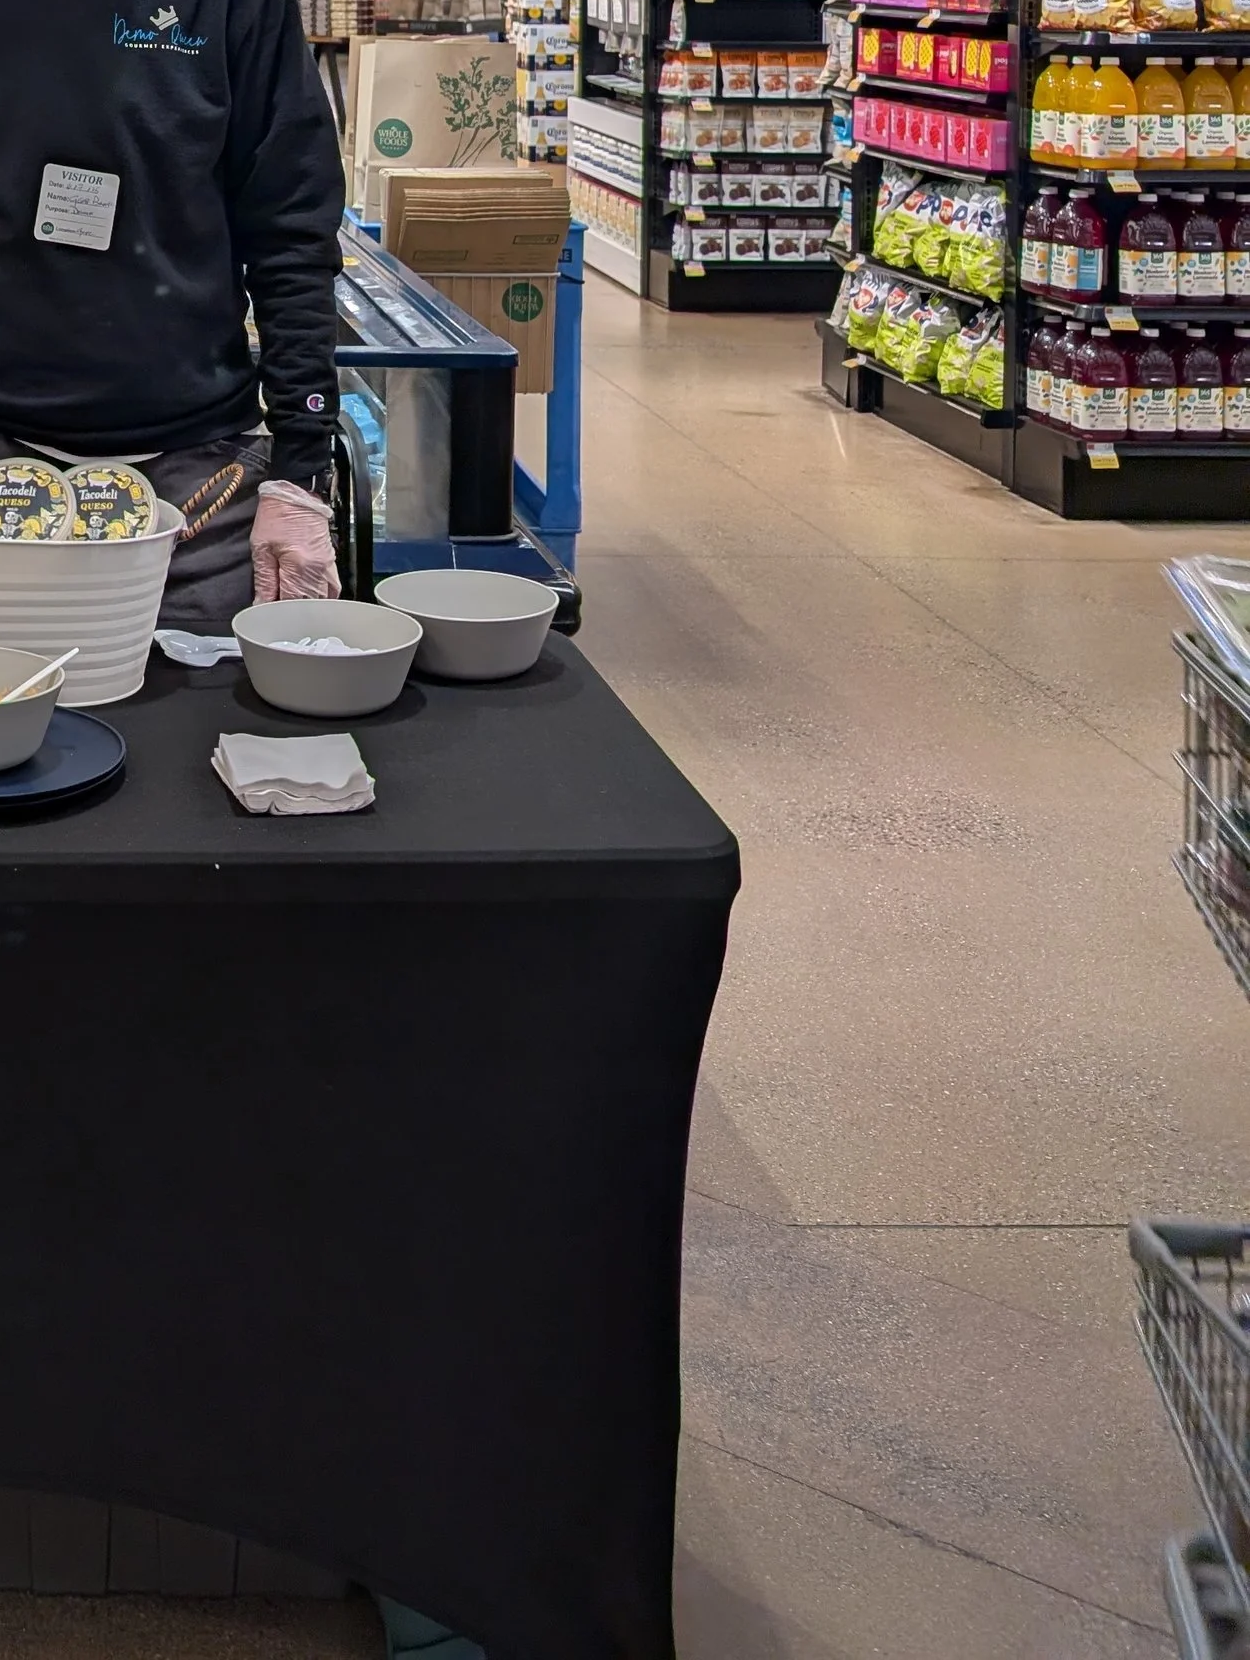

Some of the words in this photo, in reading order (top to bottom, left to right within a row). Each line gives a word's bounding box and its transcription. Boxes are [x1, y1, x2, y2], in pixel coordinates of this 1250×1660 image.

[113, 13, 159, 44] Demo
[546, 35, 569, 45] Coro
[378, 126, 409, 139] WHOLE
[379, 137, 408, 147] FOODS
[62, 171, 104, 186] VISITOR
[78, 489, 118, 500] Tacodeli
[80, 503, 113, 511] QUESO
